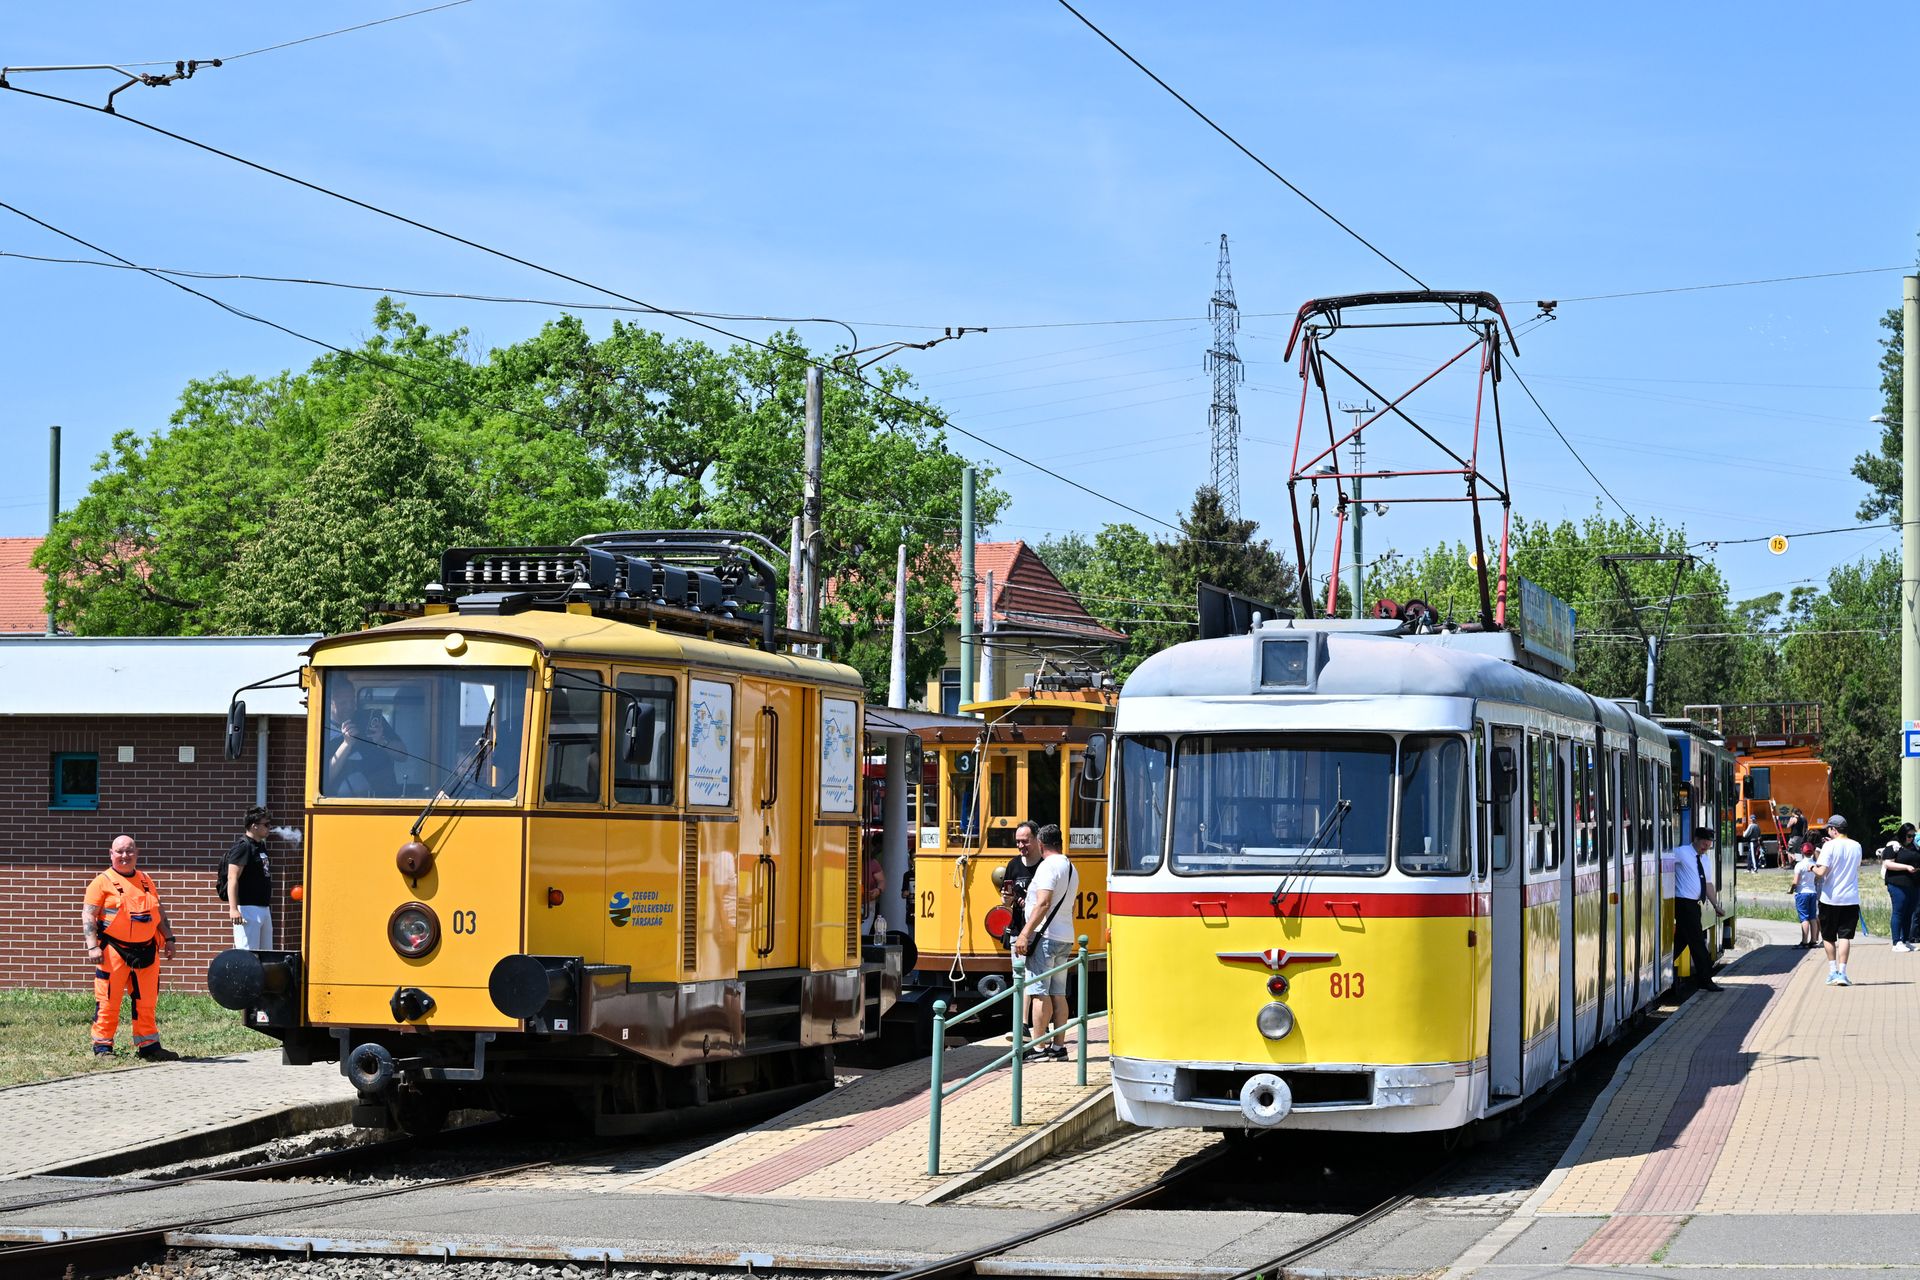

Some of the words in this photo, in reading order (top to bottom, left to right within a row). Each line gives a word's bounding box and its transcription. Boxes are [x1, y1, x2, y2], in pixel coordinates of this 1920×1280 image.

[1774, 540, 1783, 550] 15
[961, 755, 970, 771] 3
[632, 891, 659, 900] SZEGEDI
[632, 902, 674, 914] KÖZLEKEDÉSI
[920, 890, 935, 918] 12
[1075, 891, 1099, 920] 12
[453, 910, 476, 935] 03
[632, 915, 663, 927] TÁRSASÁG
[1330, 972, 1364, 999] 813
